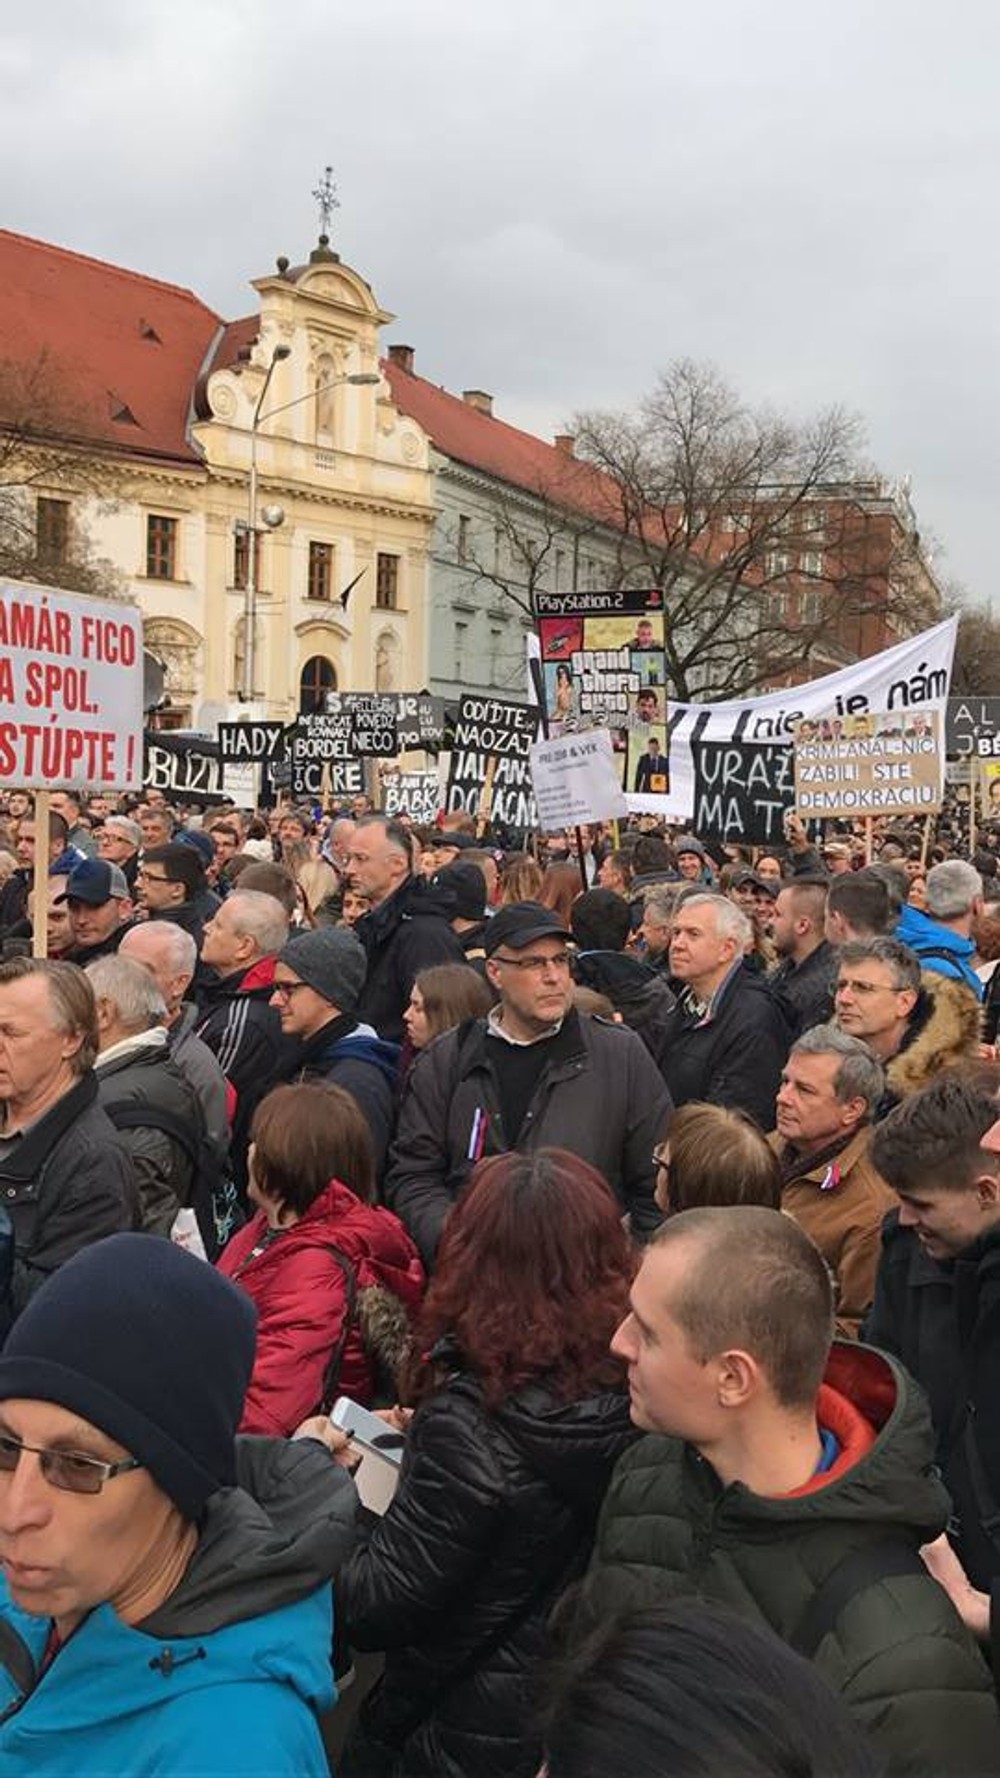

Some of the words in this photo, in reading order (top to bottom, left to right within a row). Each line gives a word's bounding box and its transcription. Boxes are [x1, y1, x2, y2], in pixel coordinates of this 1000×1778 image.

[538, 595, 611, 613] PlayStation
[81, 616, 135, 666] FICO
[571, 647, 630, 675] grand
[25, 661, 98, 713] SPOL.
[581, 670, 640, 692] theft
[887, 663, 947, 710] nám
[581, 692, 628, 711] auto
[222, 727, 280, 756] HADY
[296, 738, 353, 759] BORDEL
[454, 723, 533, 755] NAOZAJ
[126, 735, 134, 781] !
[800, 763, 858, 785] ZABILI
[873, 759, 911, 781] STE
[697, 794, 745, 836] MA
